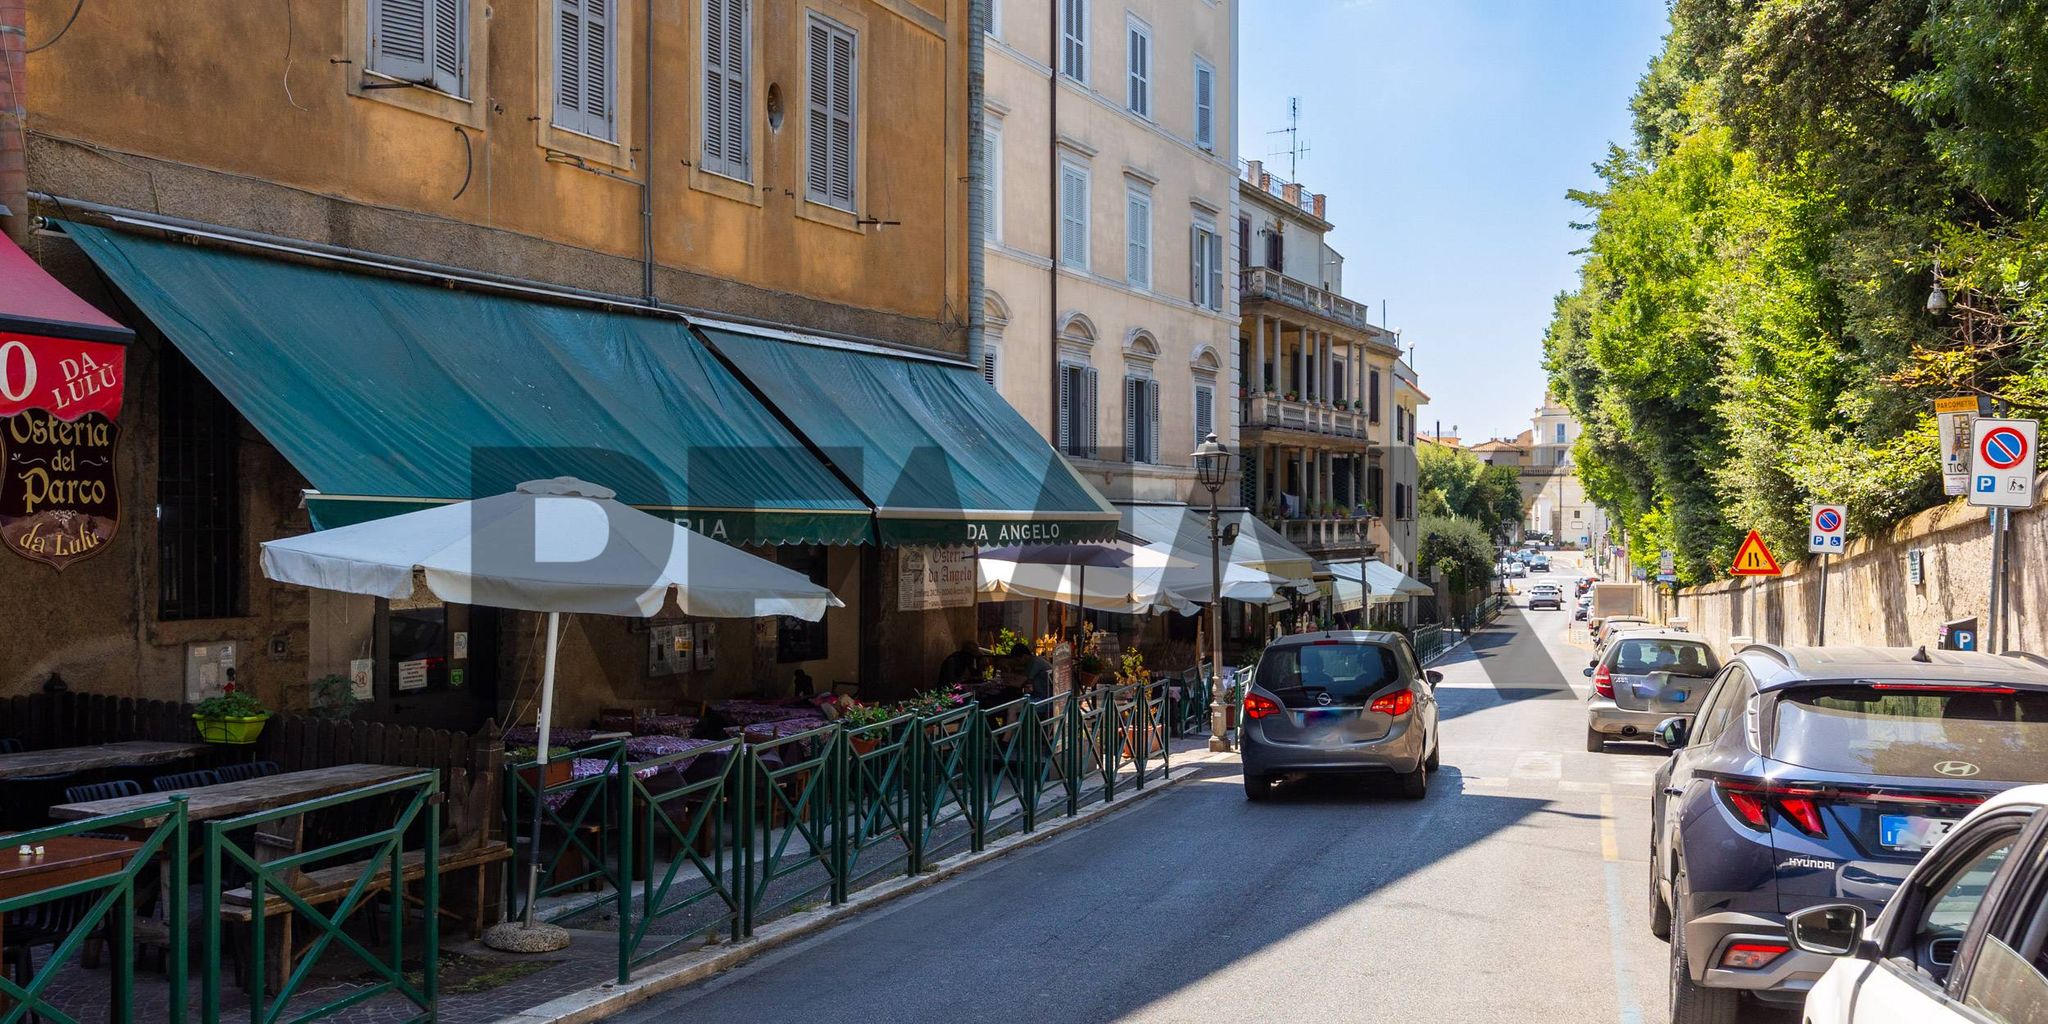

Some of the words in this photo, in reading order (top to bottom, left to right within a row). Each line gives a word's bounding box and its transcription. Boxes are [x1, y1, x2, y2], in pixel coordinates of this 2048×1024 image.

[59, 351, 99, 382] DA
[52, 362, 117, 410] LULÙ
[10, 411, 109, 447] Osteria
[51, 451, 76, 471] del
[18, 467, 106, 513] Parco
[1980, 477, 1992, 491] P
[20, 522, 46, 553] da
[54, 522, 99, 556] Lulù
[967, 523, 988, 540] DA
[999, 523, 1060, 540] ANGELO
[928, 567, 939, 583] da
[941, 565, 972, 585] Angelo
[1959, 632, 1971, 649] P
[1789, 857, 1835, 870] HYUNDAI
